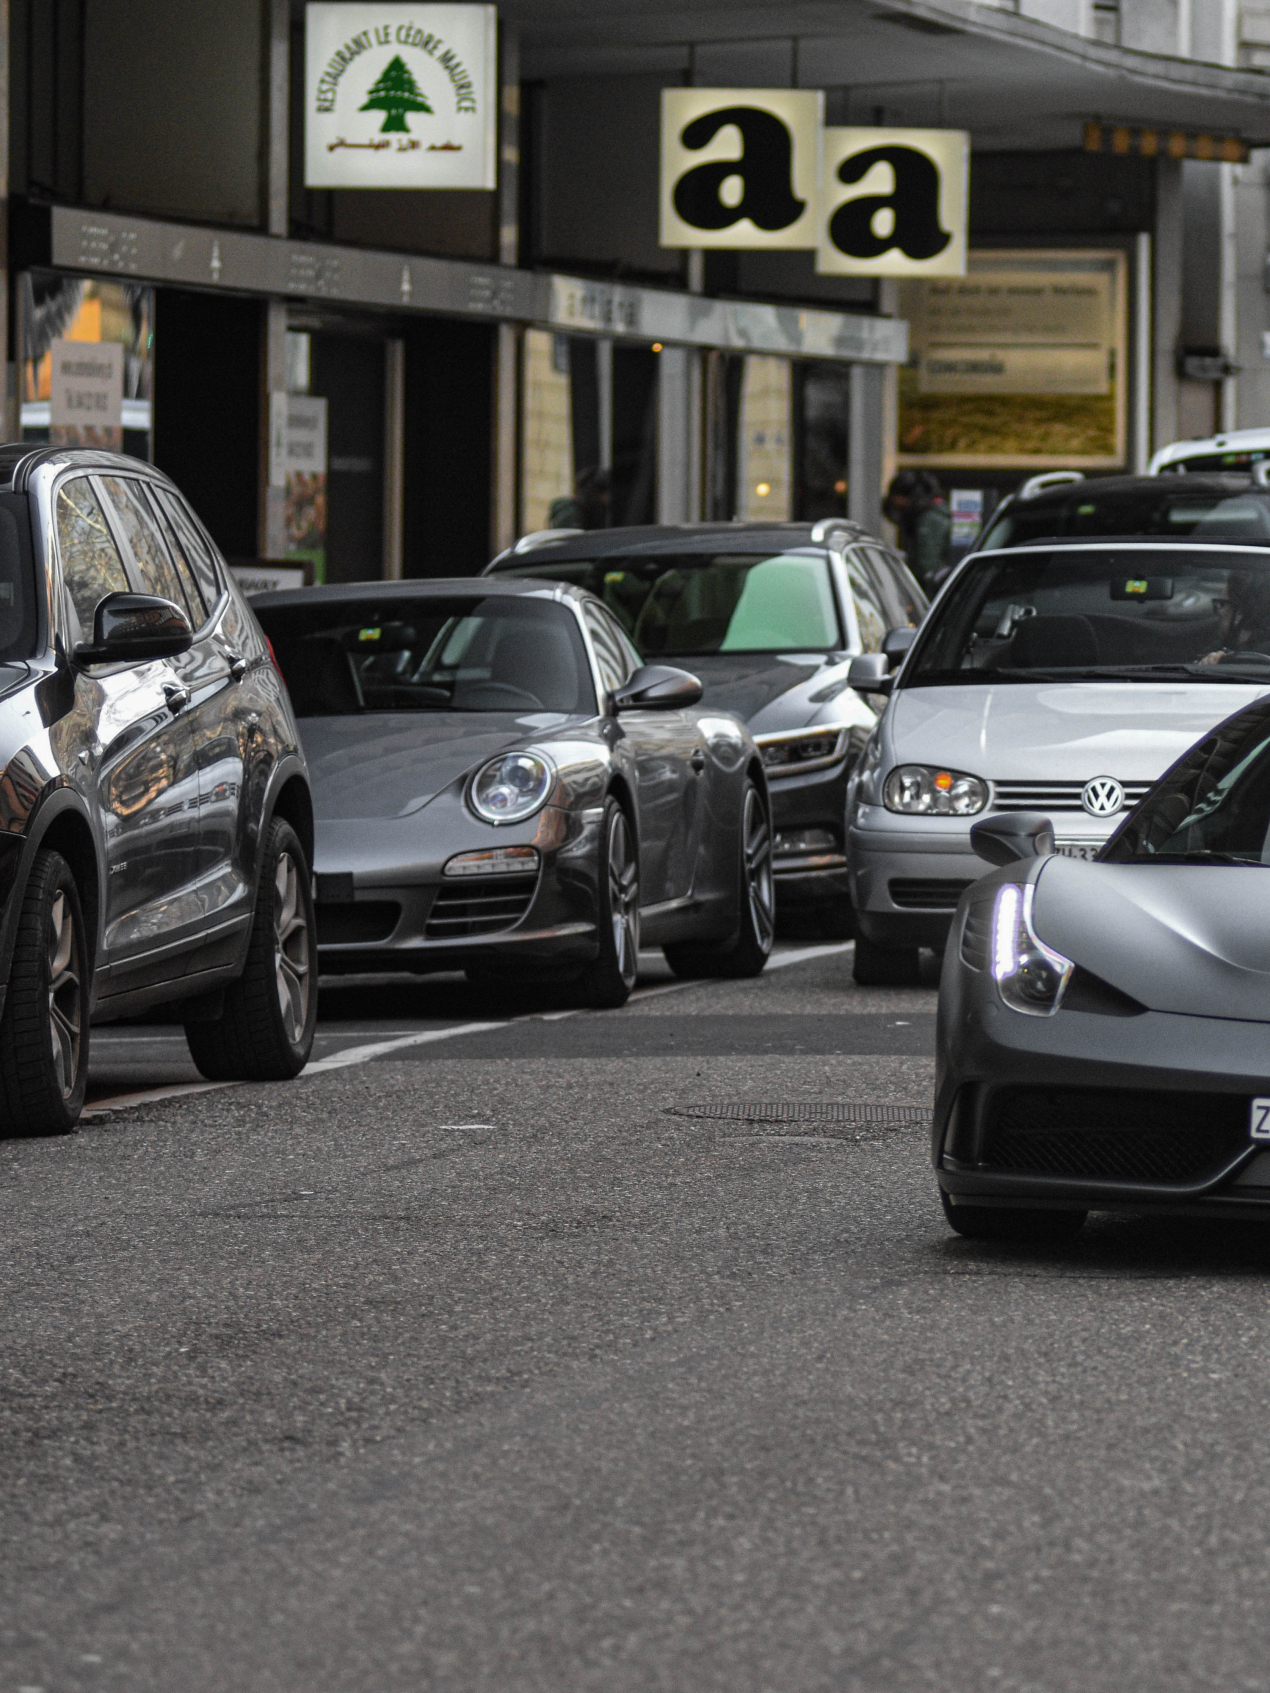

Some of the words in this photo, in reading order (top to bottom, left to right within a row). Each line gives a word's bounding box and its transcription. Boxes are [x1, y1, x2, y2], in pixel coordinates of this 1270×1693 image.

[316, 29, 373, 113] RESTAURANT
[374, 24, 392, 46] LE
[436, 48, 477, 114] MAURICE
